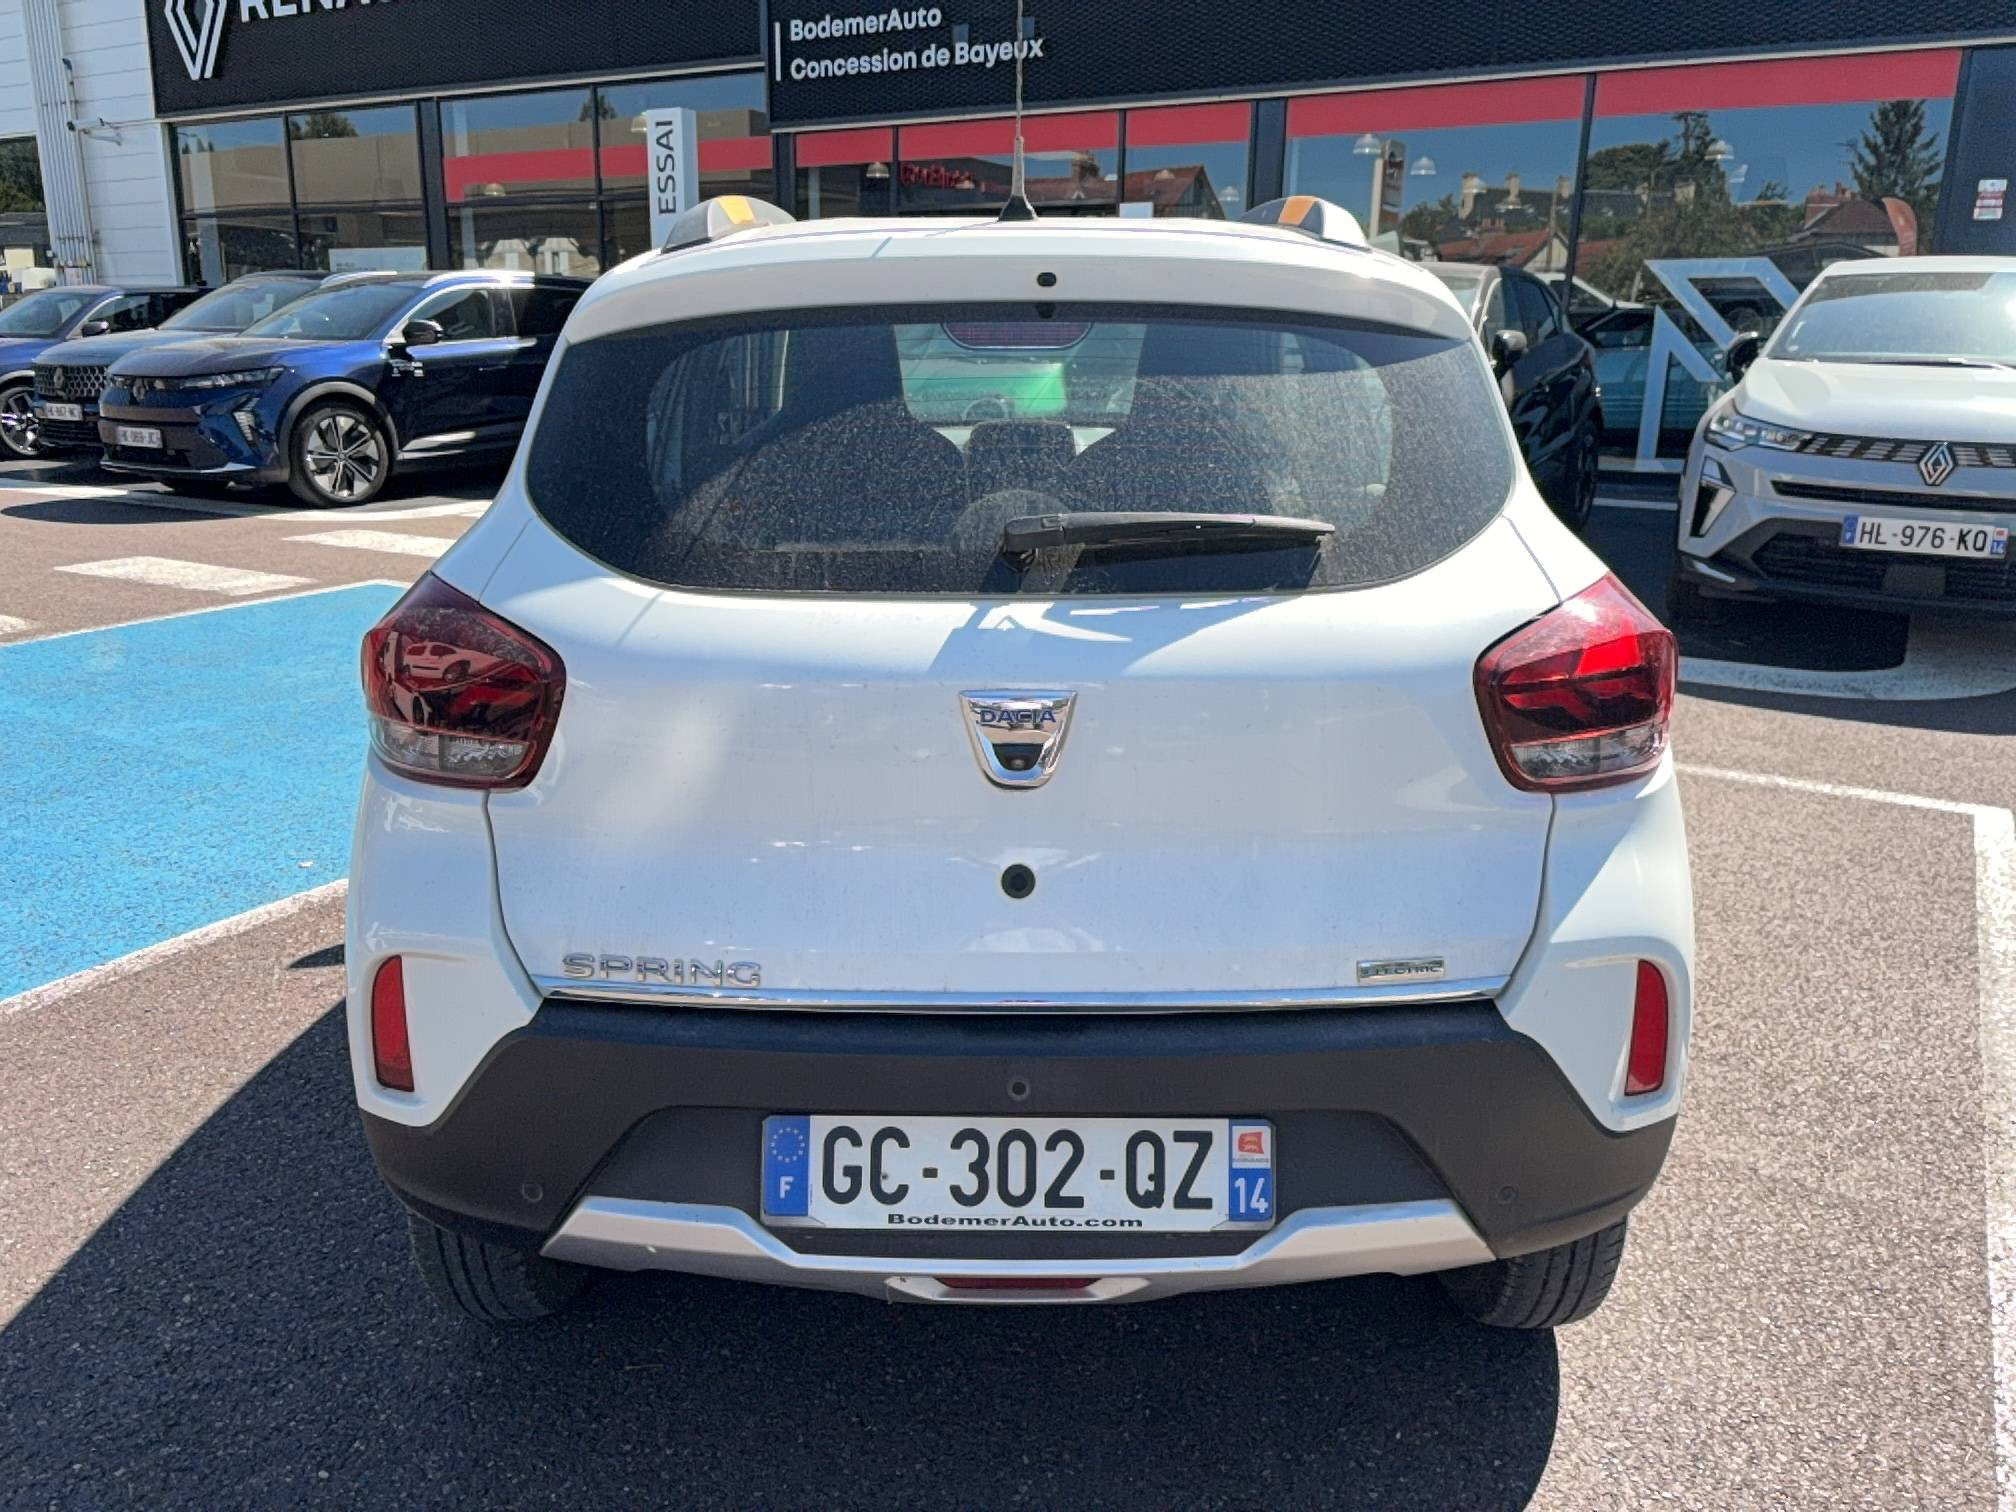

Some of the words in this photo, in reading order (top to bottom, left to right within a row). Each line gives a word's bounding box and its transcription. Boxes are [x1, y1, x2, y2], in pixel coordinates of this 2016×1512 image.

[790, 7, 942, 42] BodemerAuto
[790, 47, 918, 81] Concession
[921, 43, 952, 67] de
[954, 38, 1045, 69] Bayeux
[655, 120, 677, 215] ESSAI
[980, 706, 1057, 723] DACIA
[562, 952, 762, 988] SPRING
[822, 1125, 1214, 1210] GC-302-QZ
[779, 1175, 795, 1199] F
[1234, 1176, 1269, 1214] 14
[887, 1212, 1143, 1228] BodemerAuto.com
